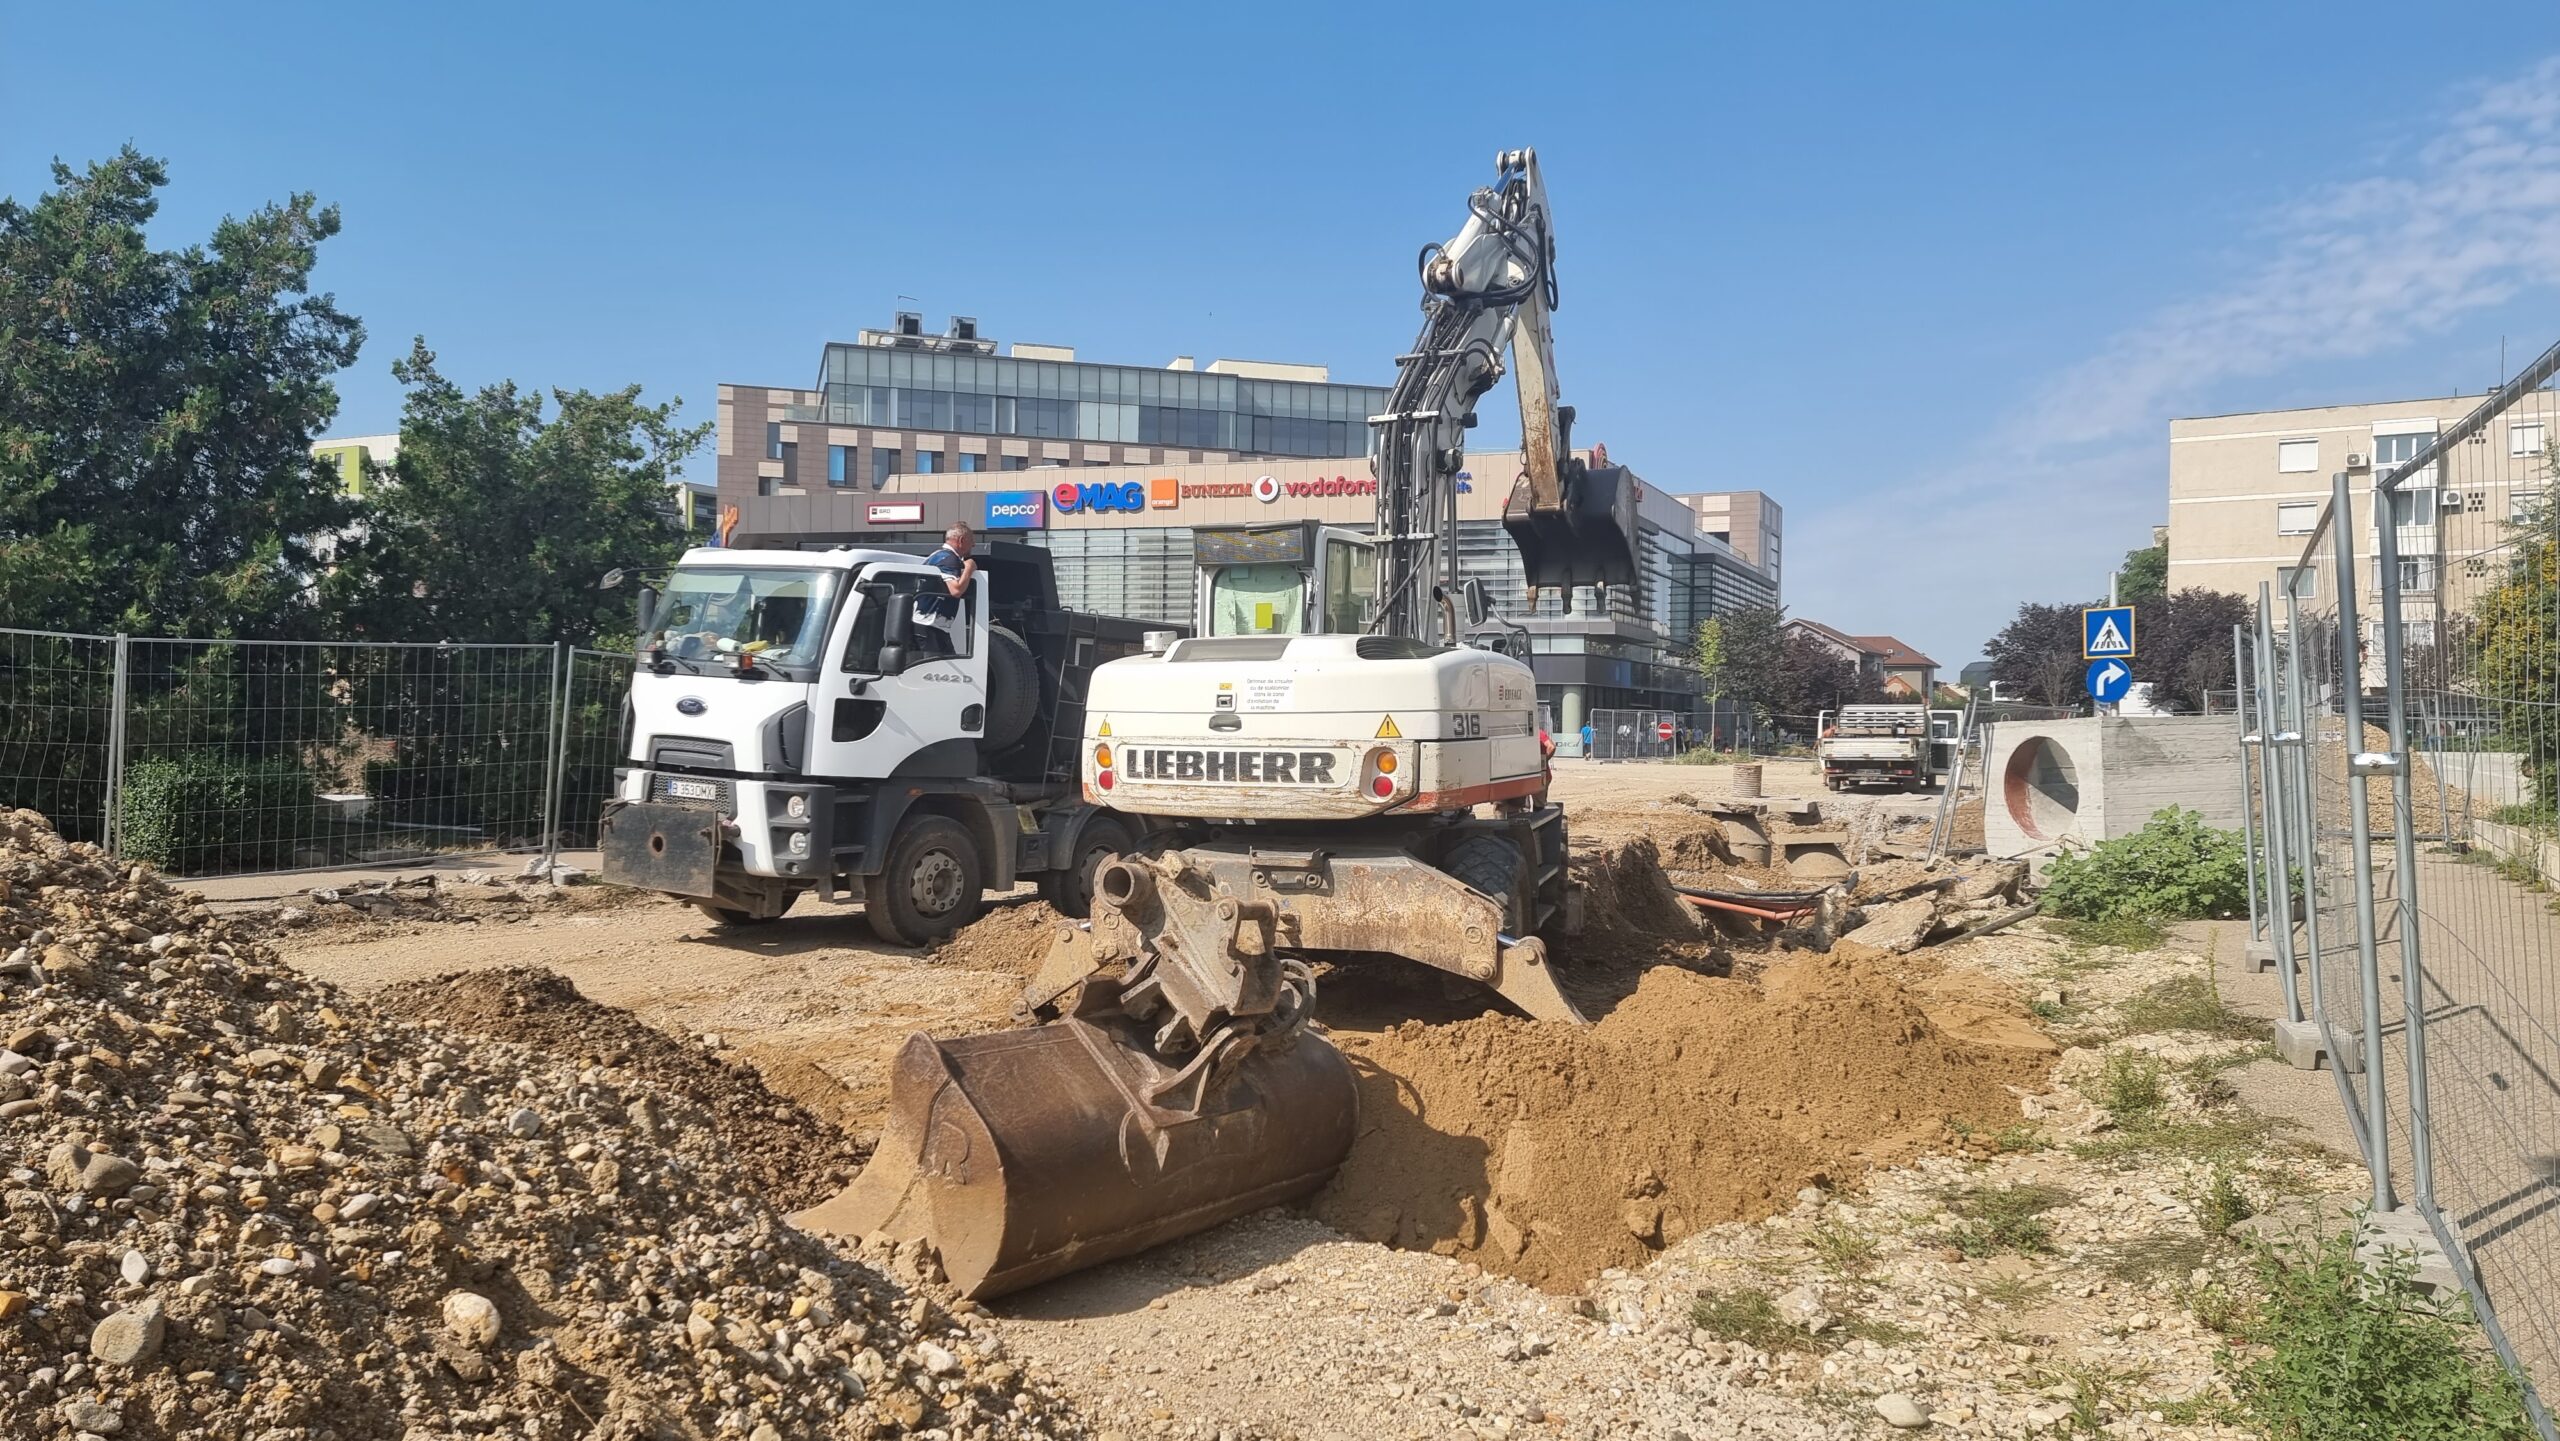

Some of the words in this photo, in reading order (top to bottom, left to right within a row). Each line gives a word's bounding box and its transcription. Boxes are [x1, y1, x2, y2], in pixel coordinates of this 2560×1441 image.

[1052, 482, 1144, 512] eMAG
[1285, 476, 1377, 498] vodafone
[992, 503, 1040, 517] pepco
[1453, 713, 1480, 736] 316
[1127, 749, 1337, 783] LIEBHERR
